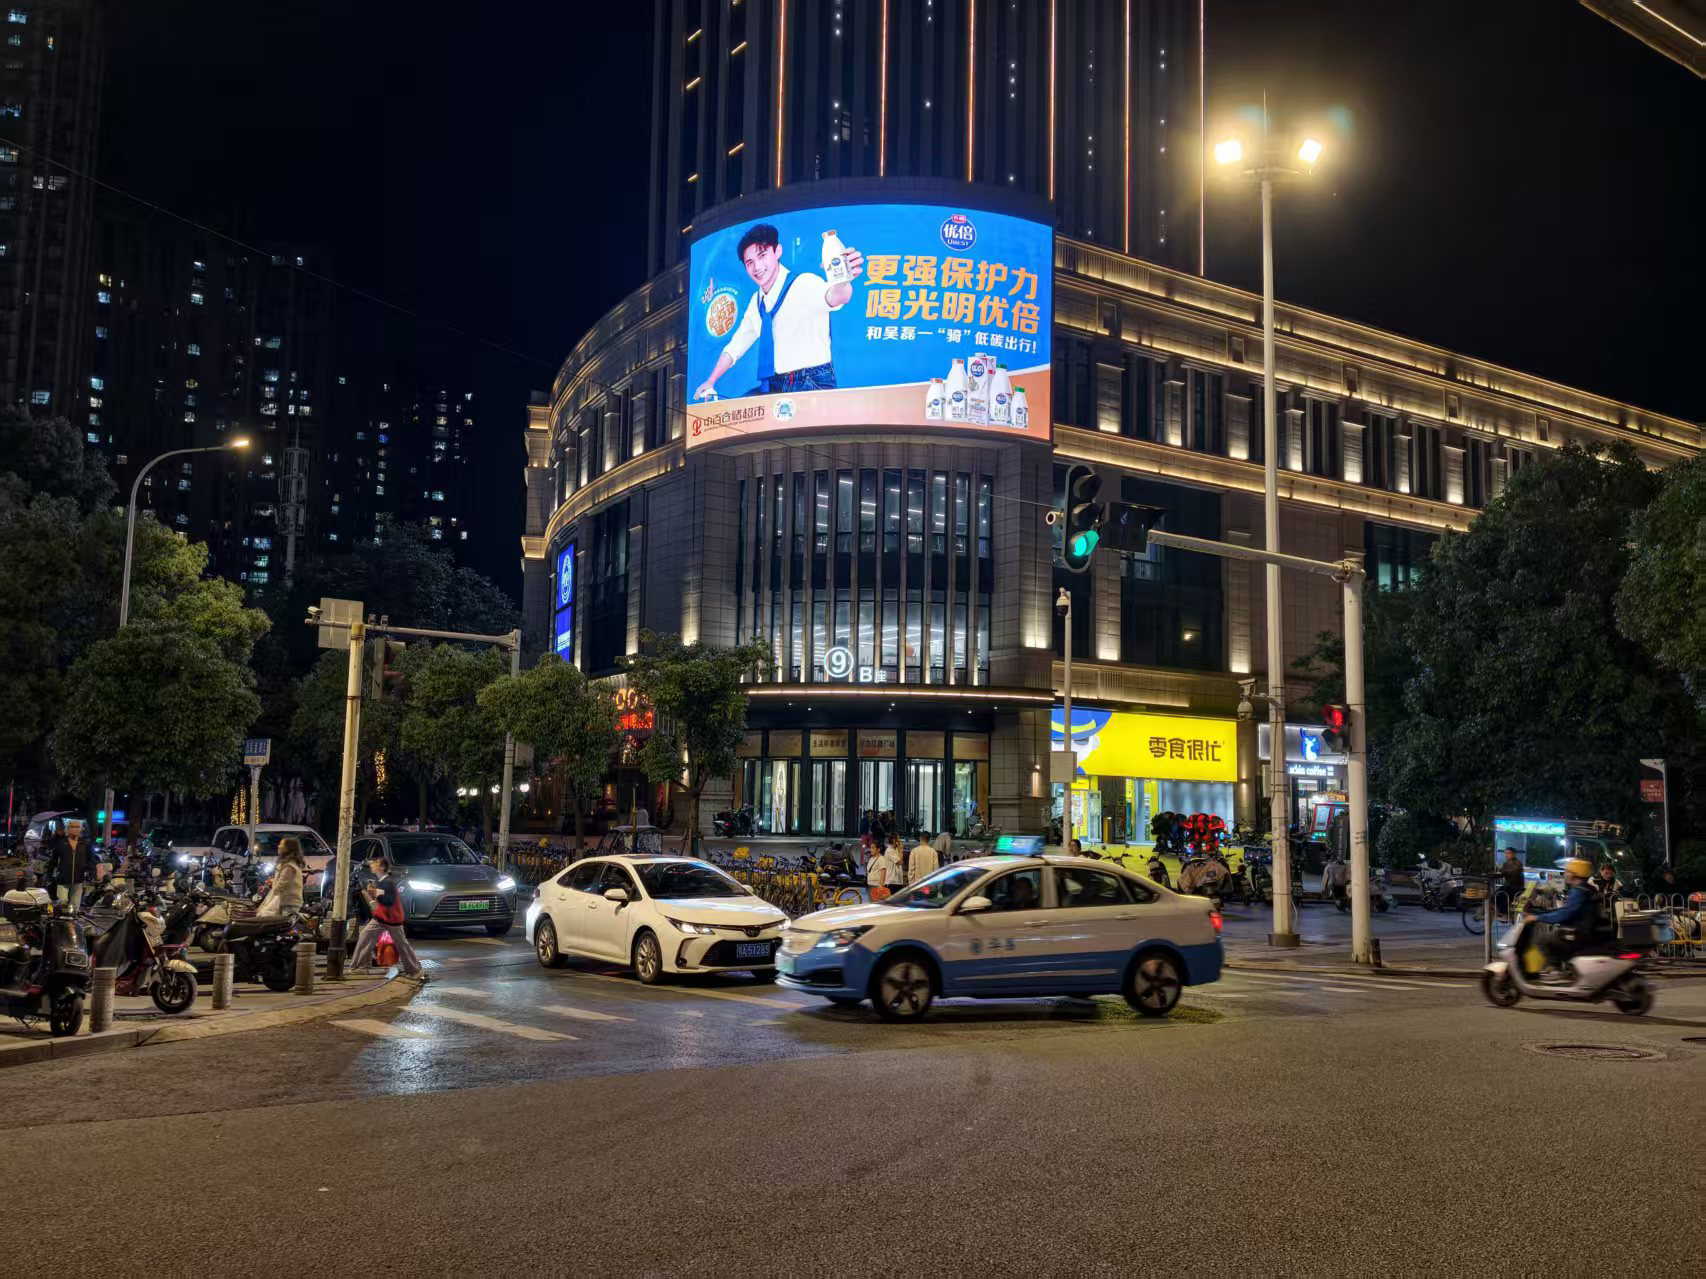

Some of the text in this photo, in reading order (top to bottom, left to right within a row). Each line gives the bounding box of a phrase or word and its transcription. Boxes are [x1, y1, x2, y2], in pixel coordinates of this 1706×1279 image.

[944, 224, 973, 240] 优倍
[864, 254, 1038, 299] 更强保护力
[866, 288, 1041, 334] 喝光明优倍
[703, 405, 765, 427] 中百仓储超市
[860, 667, 887, 683] B座
[1149, 736, 1222, 762] 零食很忙
